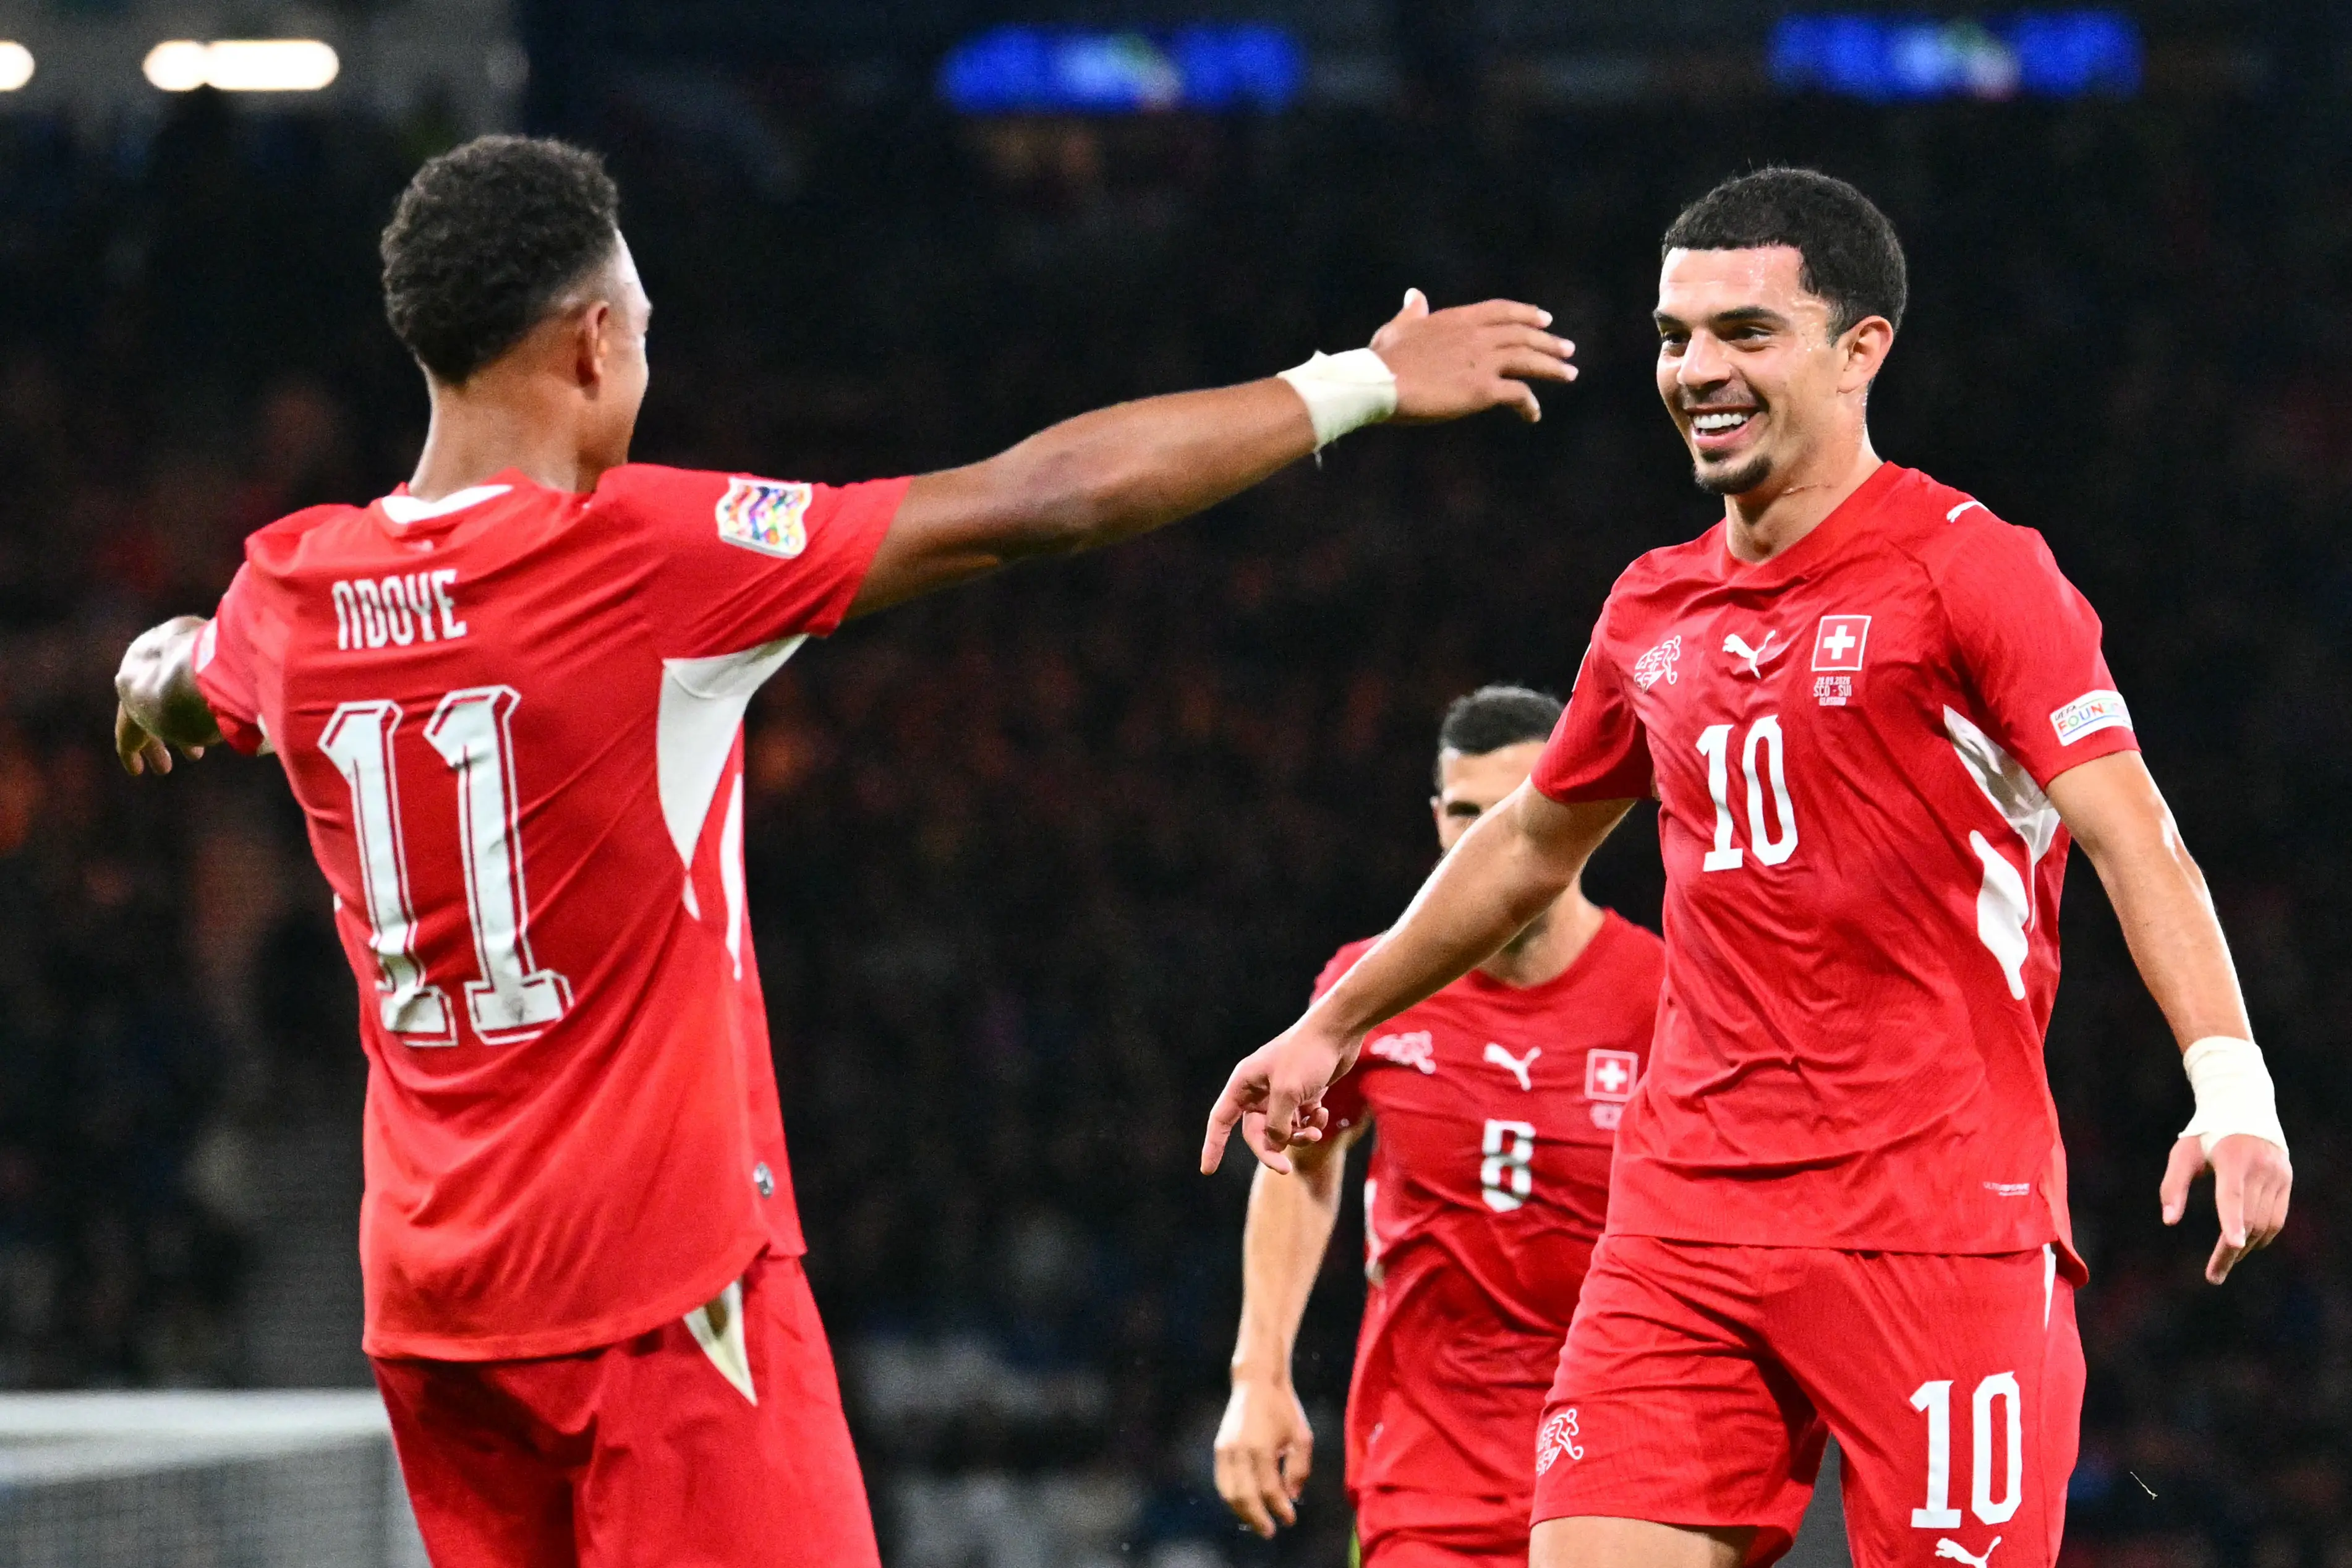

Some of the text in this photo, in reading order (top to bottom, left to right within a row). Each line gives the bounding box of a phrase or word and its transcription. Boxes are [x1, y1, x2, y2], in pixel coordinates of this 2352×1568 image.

[331, 568, 467, 650] NDOYE
[1813, 684, 1830, 697] SCO
[1838, 684, 1852, 697] SUI
[2055, 705, 2077, 721] UEFA
[1695, 714, 1799, 872] 10
[318, 685, 574, 1046] 11
[1480, 1119, 1536, 1212] 8
[1909, 1371, 2022, 1528] 10
